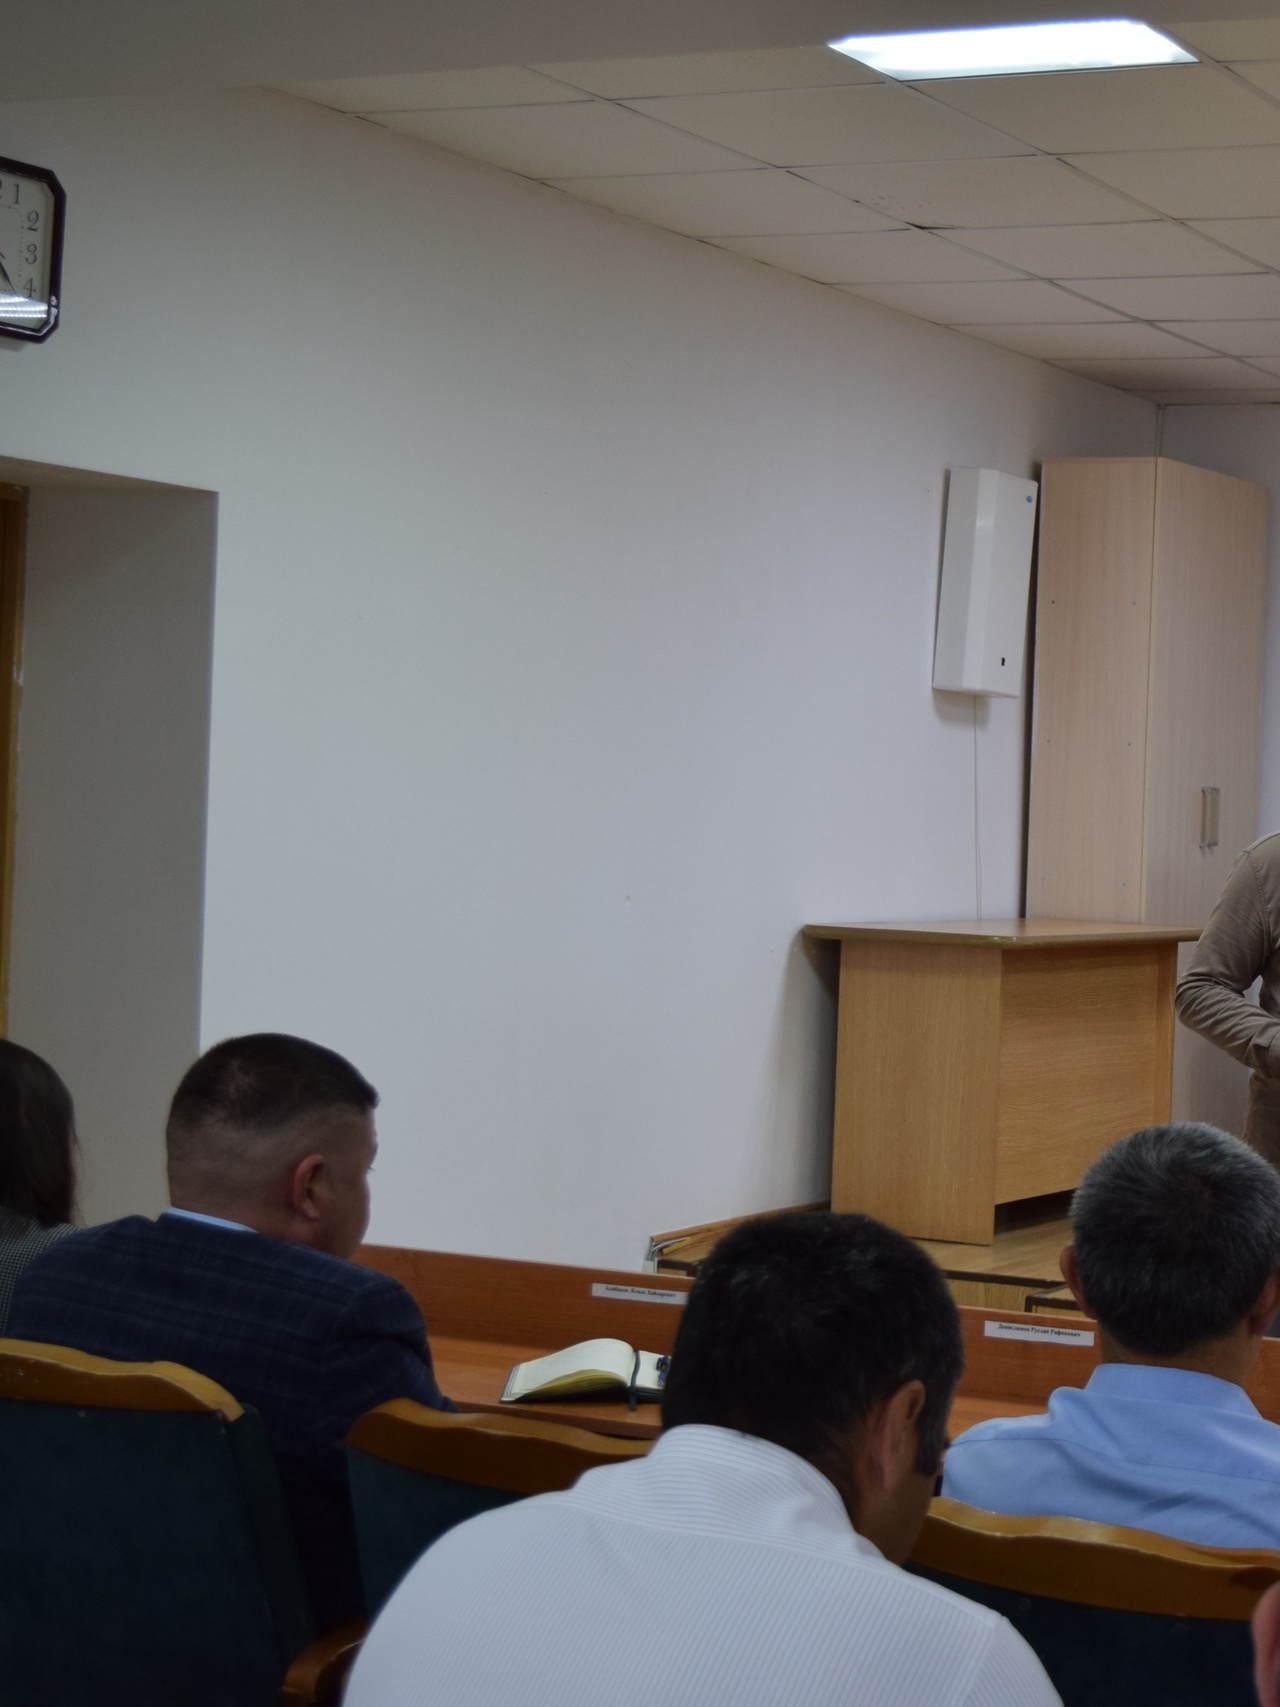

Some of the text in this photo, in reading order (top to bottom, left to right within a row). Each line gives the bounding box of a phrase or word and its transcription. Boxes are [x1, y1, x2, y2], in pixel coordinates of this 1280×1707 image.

[14, 184, 20, 204] 1
[27, 210, 40, 231] 2
[25, 243, 37, 264] 3
[23, 278, 37, 299] 4
